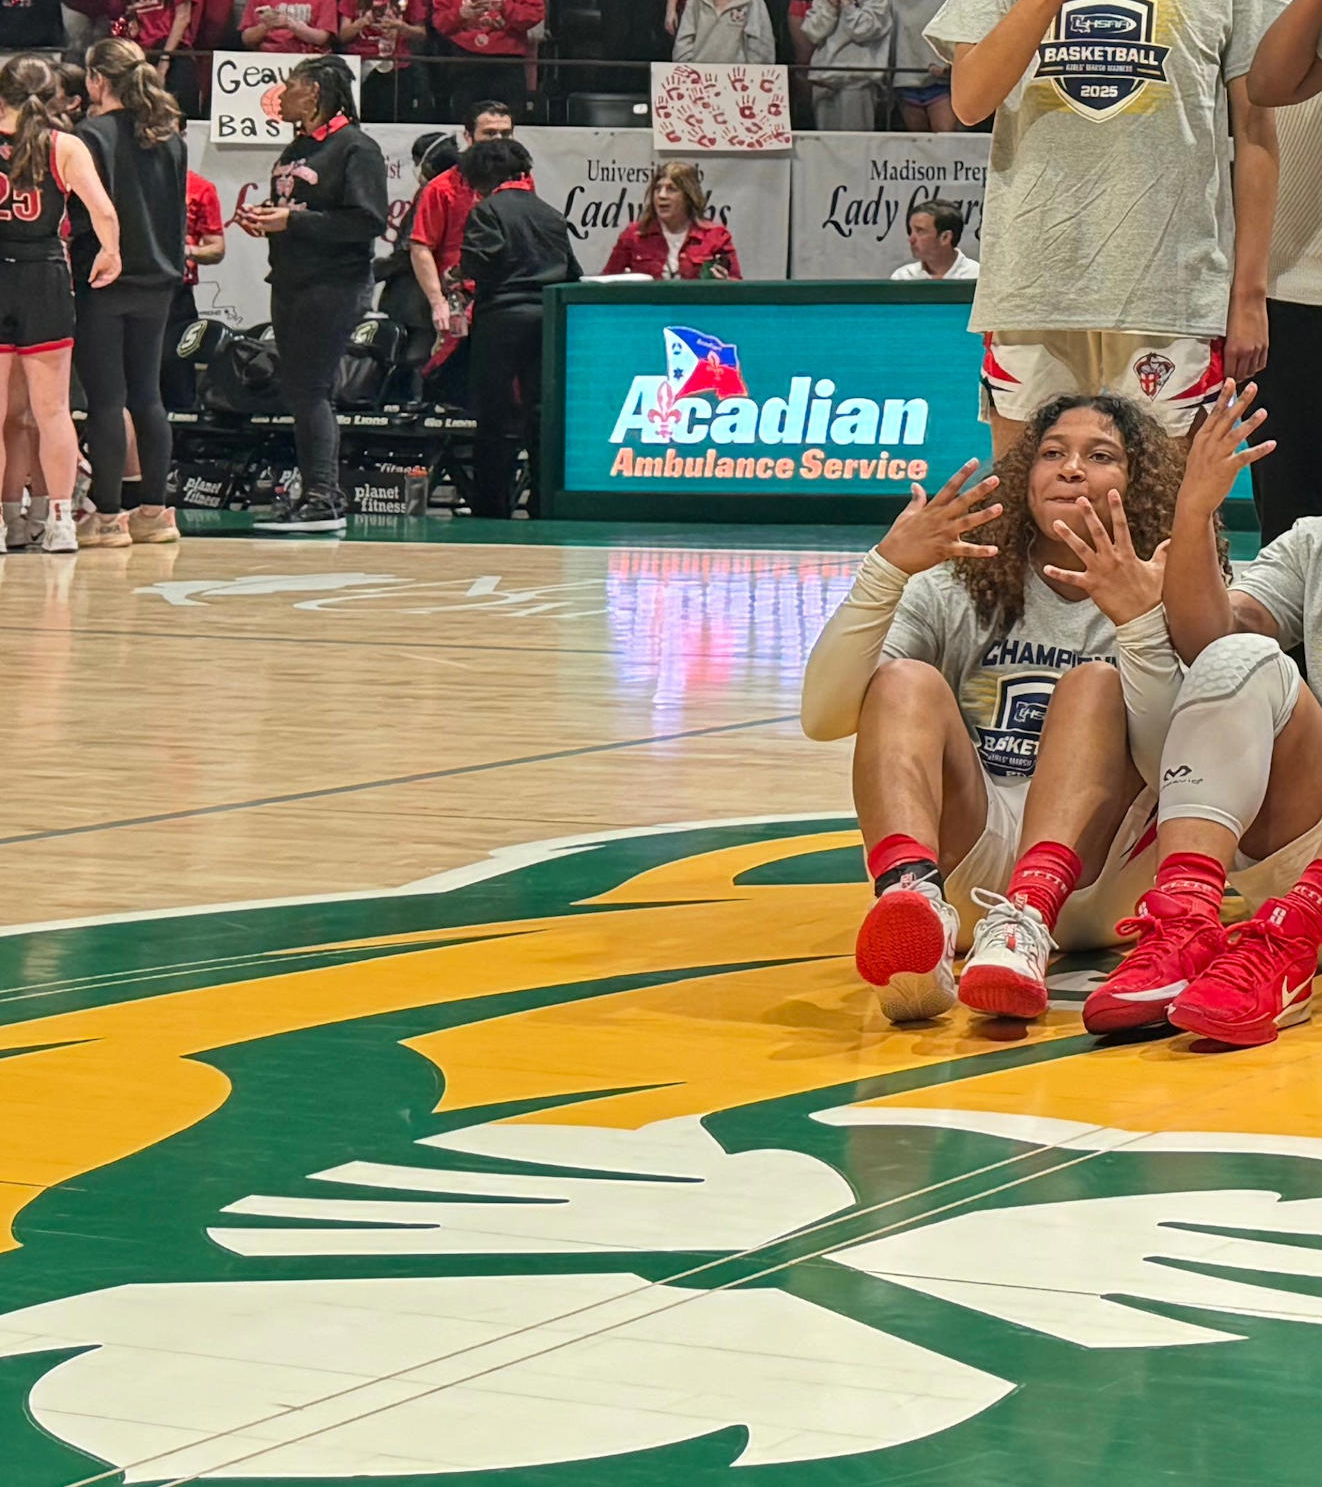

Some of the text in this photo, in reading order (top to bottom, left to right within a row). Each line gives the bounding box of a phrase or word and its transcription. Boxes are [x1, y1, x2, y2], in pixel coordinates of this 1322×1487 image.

[1043, 46, 1160, 66] BASKETBALL
[1080, 84, 1119, 99] 2025
[587, 160, 658, 183] Universi
[870, 160, 949, 183] Madison
[823, 185, 900, 242] Lady
[609, 376, 930, 445] Acadian
[610, 448, 929, 480] Ambulance Service
[184, 477, 222, 495] planet
[355, 483, 401, 501] planet
[361, 498, 406, 514] fitness
